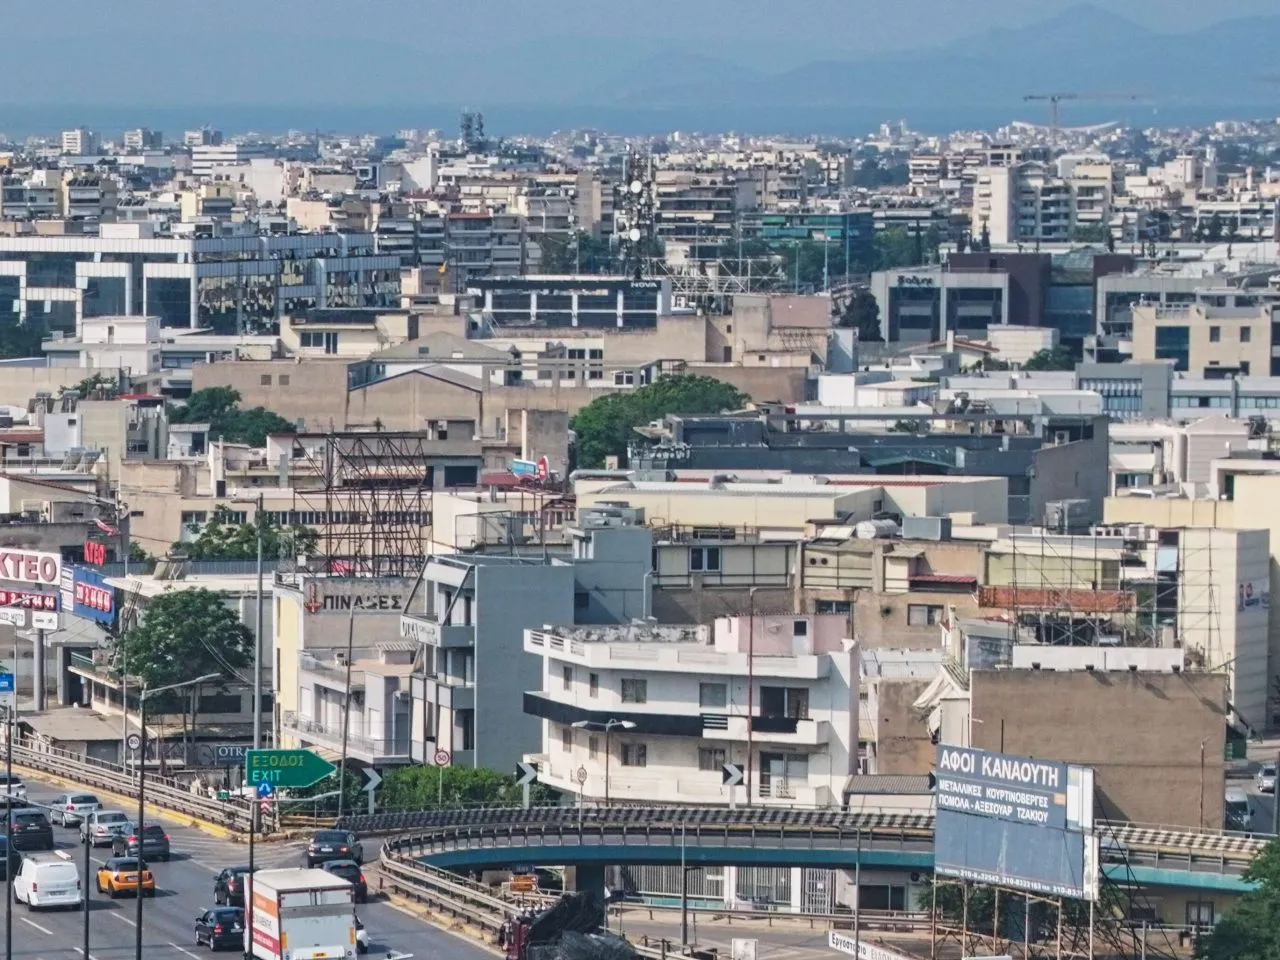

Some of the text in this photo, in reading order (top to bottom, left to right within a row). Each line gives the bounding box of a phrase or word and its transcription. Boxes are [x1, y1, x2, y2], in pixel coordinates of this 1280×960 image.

[252, 755, 305, 767] ΕΞΟΔΟΣ
[252, 770, 282, 781] EXIT
[940, 750, 1059, 787] ΑΦΟΙ ΚΑΝΑΟΥΤΗ
[938, 793, 970, 810] ΠΟΜΟΛΑ
[974, 801, 1013, 818] ΑΞΕΣΟΥΑΡ
[1016, 807, 1049, 823] ΤΖΑΚΙΟΥ
[939, 779, 1049, 808] ΜΕΤΑΛΛΙΚΕΣ ΚΟΥΡΤΙΝΟΒΕΡΓΕΣ
